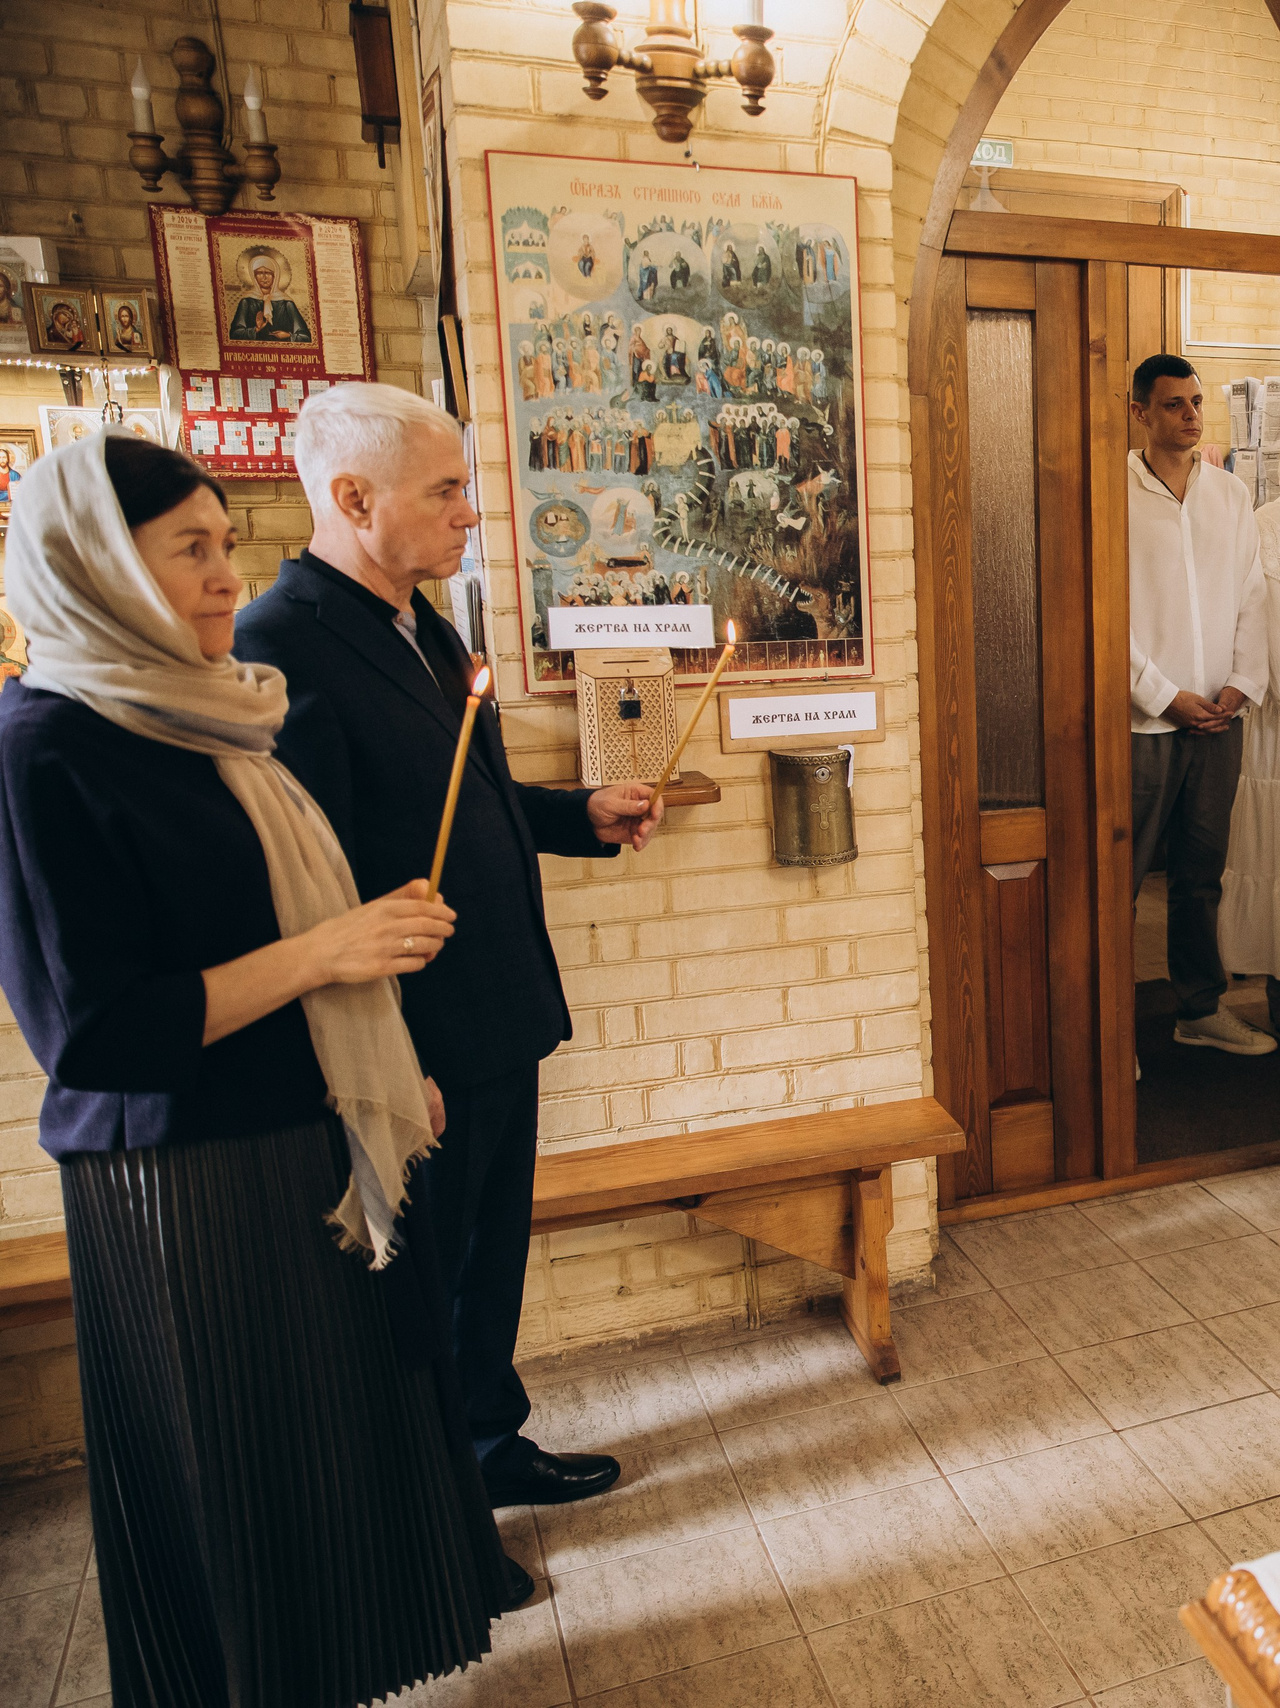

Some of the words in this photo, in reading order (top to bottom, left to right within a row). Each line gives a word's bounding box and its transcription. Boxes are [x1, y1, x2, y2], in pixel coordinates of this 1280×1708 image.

[223, 352, 279, 363] ПРАВОСЛАВНЫЙ
[281, 354, 320, 365] КАЛЕНДАРЬ
[574, 623, 629, 633] ЖЕРТВА
[633, 623, 651, 633] НА
[654, 623, 692, 633] ХРАМ
[752, 713, 801, 724] ЖЕРТВА
[804, 711, 820, 721] НА
[823, 709, 857, 720] ХРАМ
